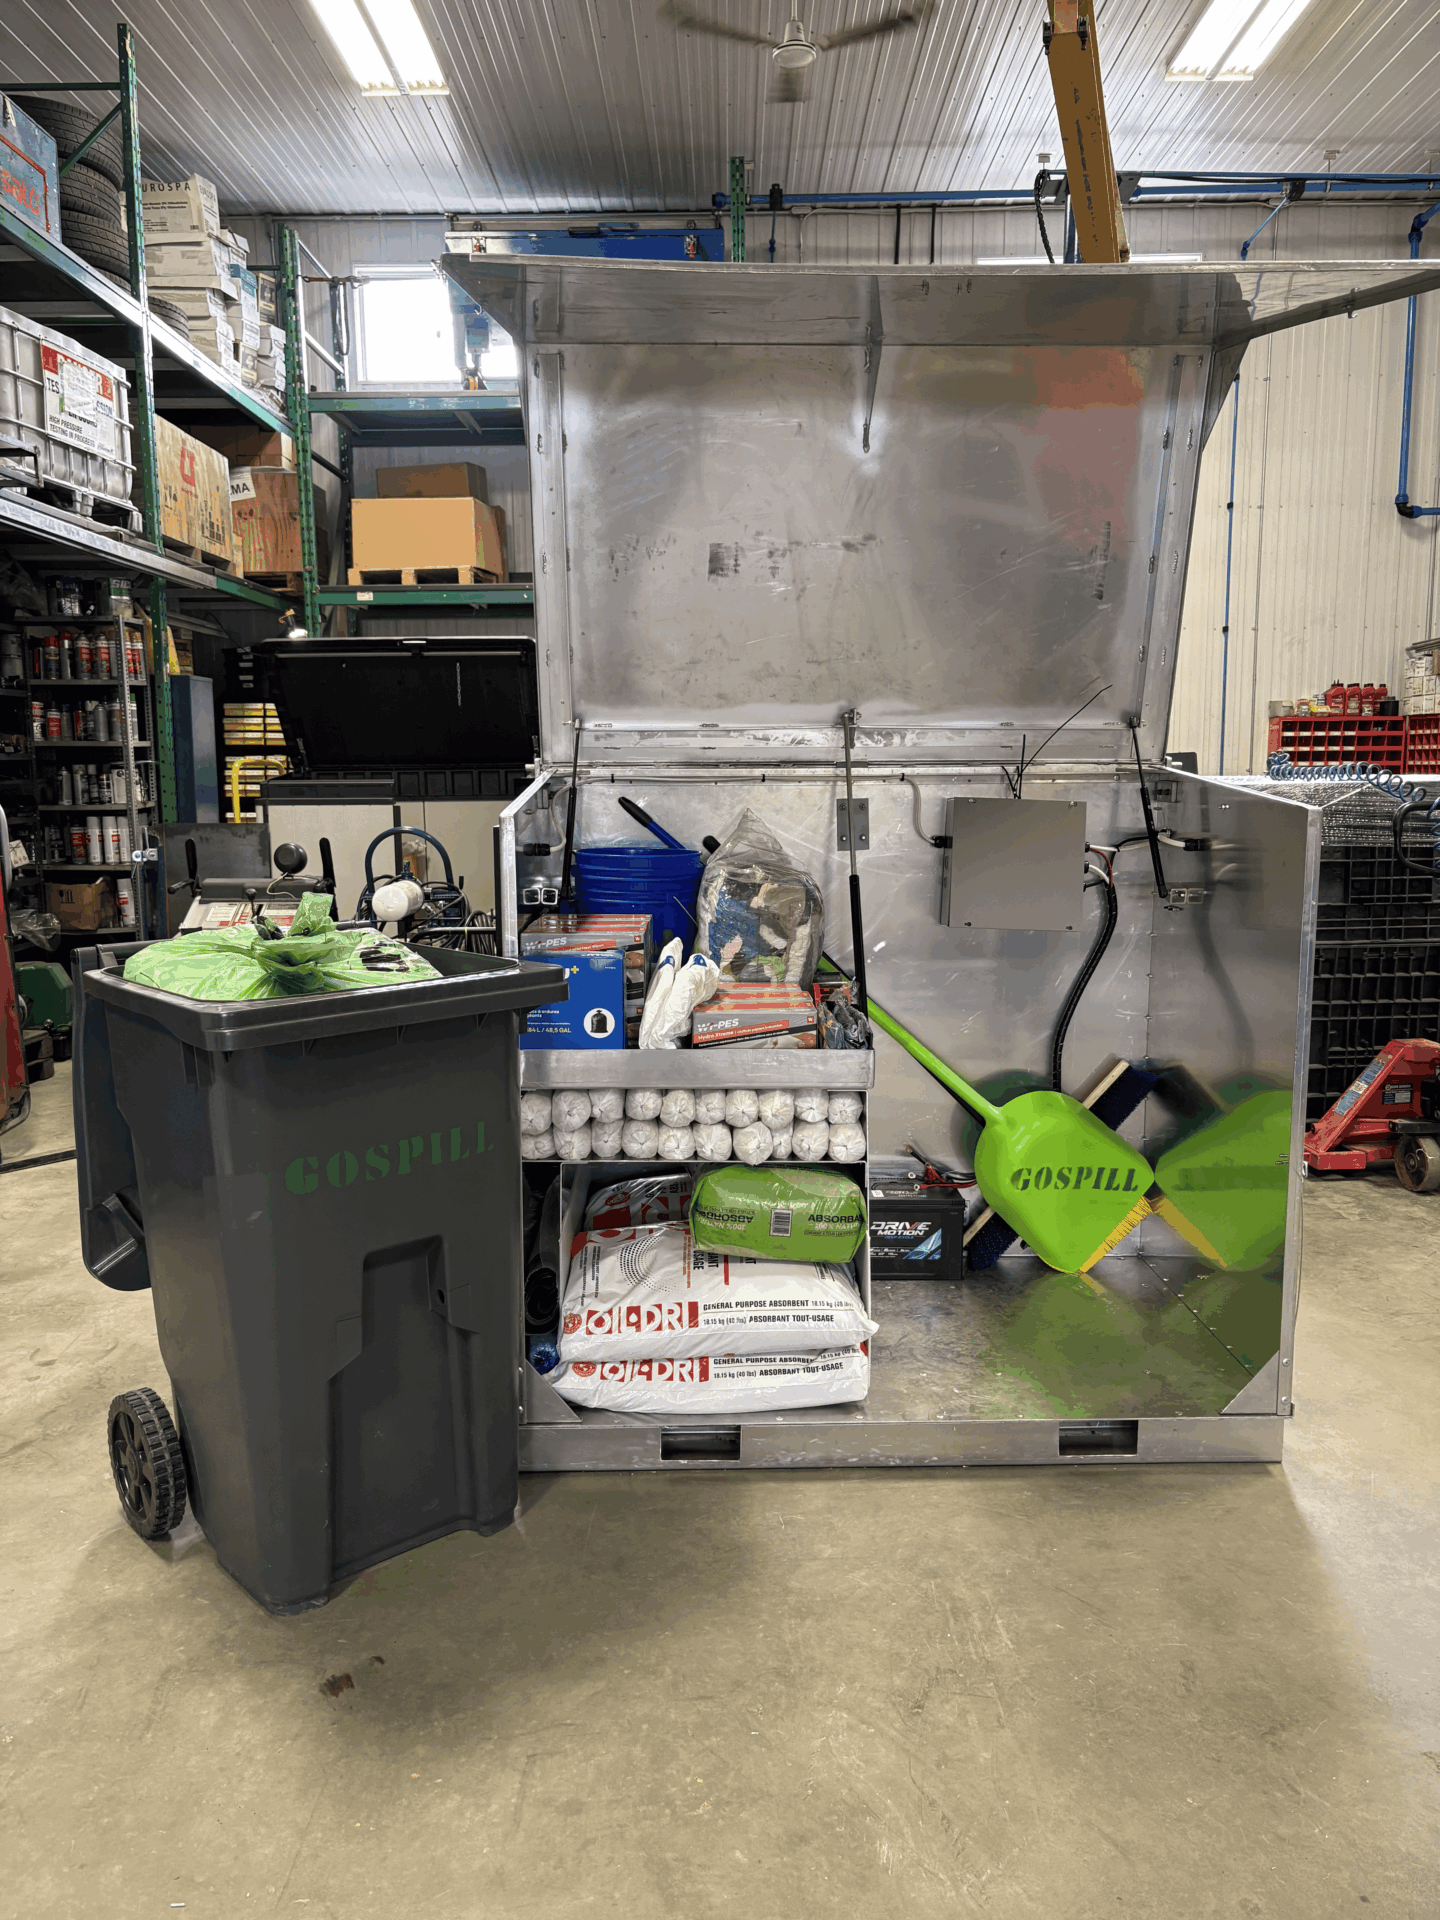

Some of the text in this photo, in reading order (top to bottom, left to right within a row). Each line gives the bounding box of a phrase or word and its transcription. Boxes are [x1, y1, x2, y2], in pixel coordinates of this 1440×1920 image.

[142, 183, 191, 192] UROSPA
[46, 377, 60, 394] TES
[49, 414, 60, 425] HIGH
[61, 418, 83, 434] PRESSURE
[50, 424, 95, 447] TESTING IN PROGRESS
[230, 482, 250, 495] MA
[284, 1122, 494, 1194] GOSPILL
[1010, 1166, 1138, 1192] GOSPILL
[699, 1211, 754, 1223] ABSORB
[808, 1214, 861, 1223] ABSORBA
[870, 1222, 932, 1230] DRIVE
[703, 1301, 733, 1311] GENERAL
[759, 1368, 800, 1376] ABSORBANT
[802, 1362, 843, 1374] TOUT-USAGE
